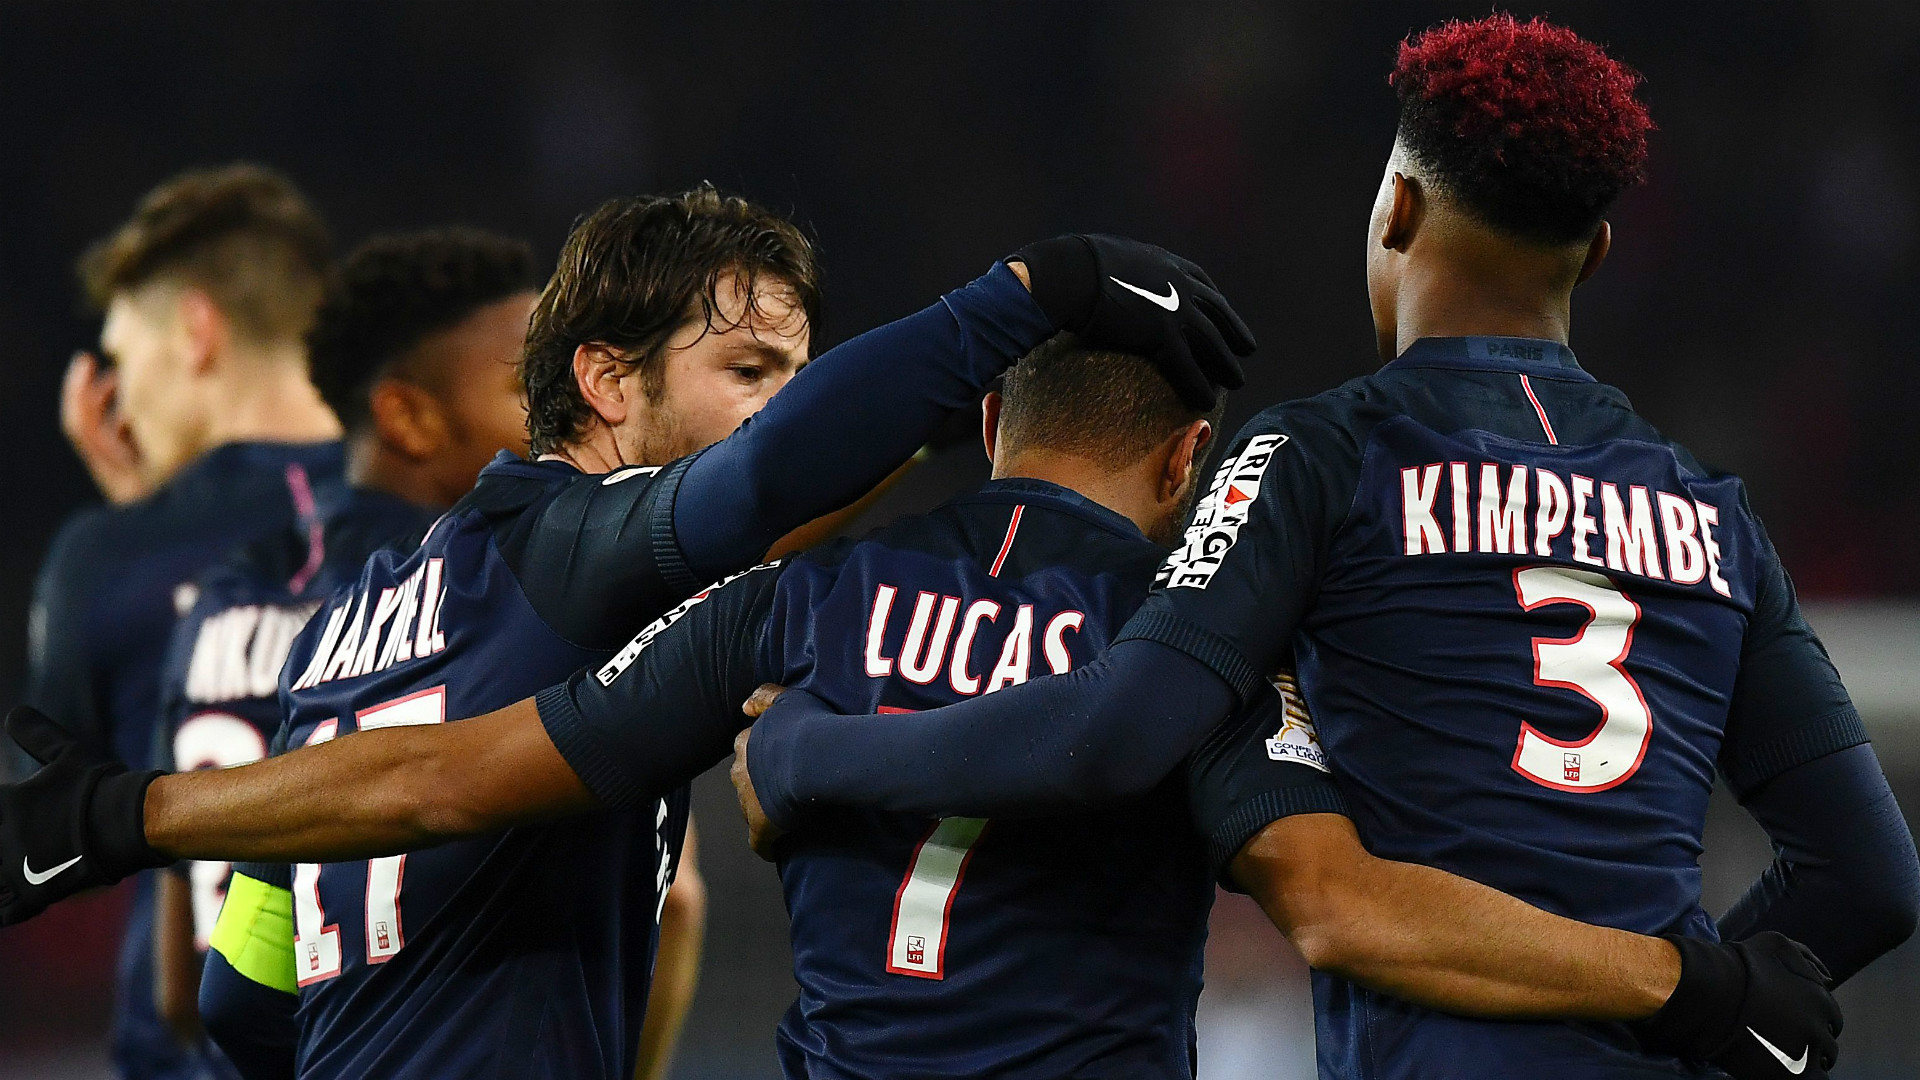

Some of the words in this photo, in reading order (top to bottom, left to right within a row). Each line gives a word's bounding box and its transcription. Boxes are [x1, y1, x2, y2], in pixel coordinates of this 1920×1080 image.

[1400, 461, 1732, 599] KIMPEMBE
[864, 583, 1086, 696] LUCAS
[1511, 564, 1654, 793] 3
[1270, 747, 1289, 755] LA
[1274, 742, 1312, 753] COUPE
[1564, 770, 1579, 779] LFP
[908, 953, 923, 961] LFP
